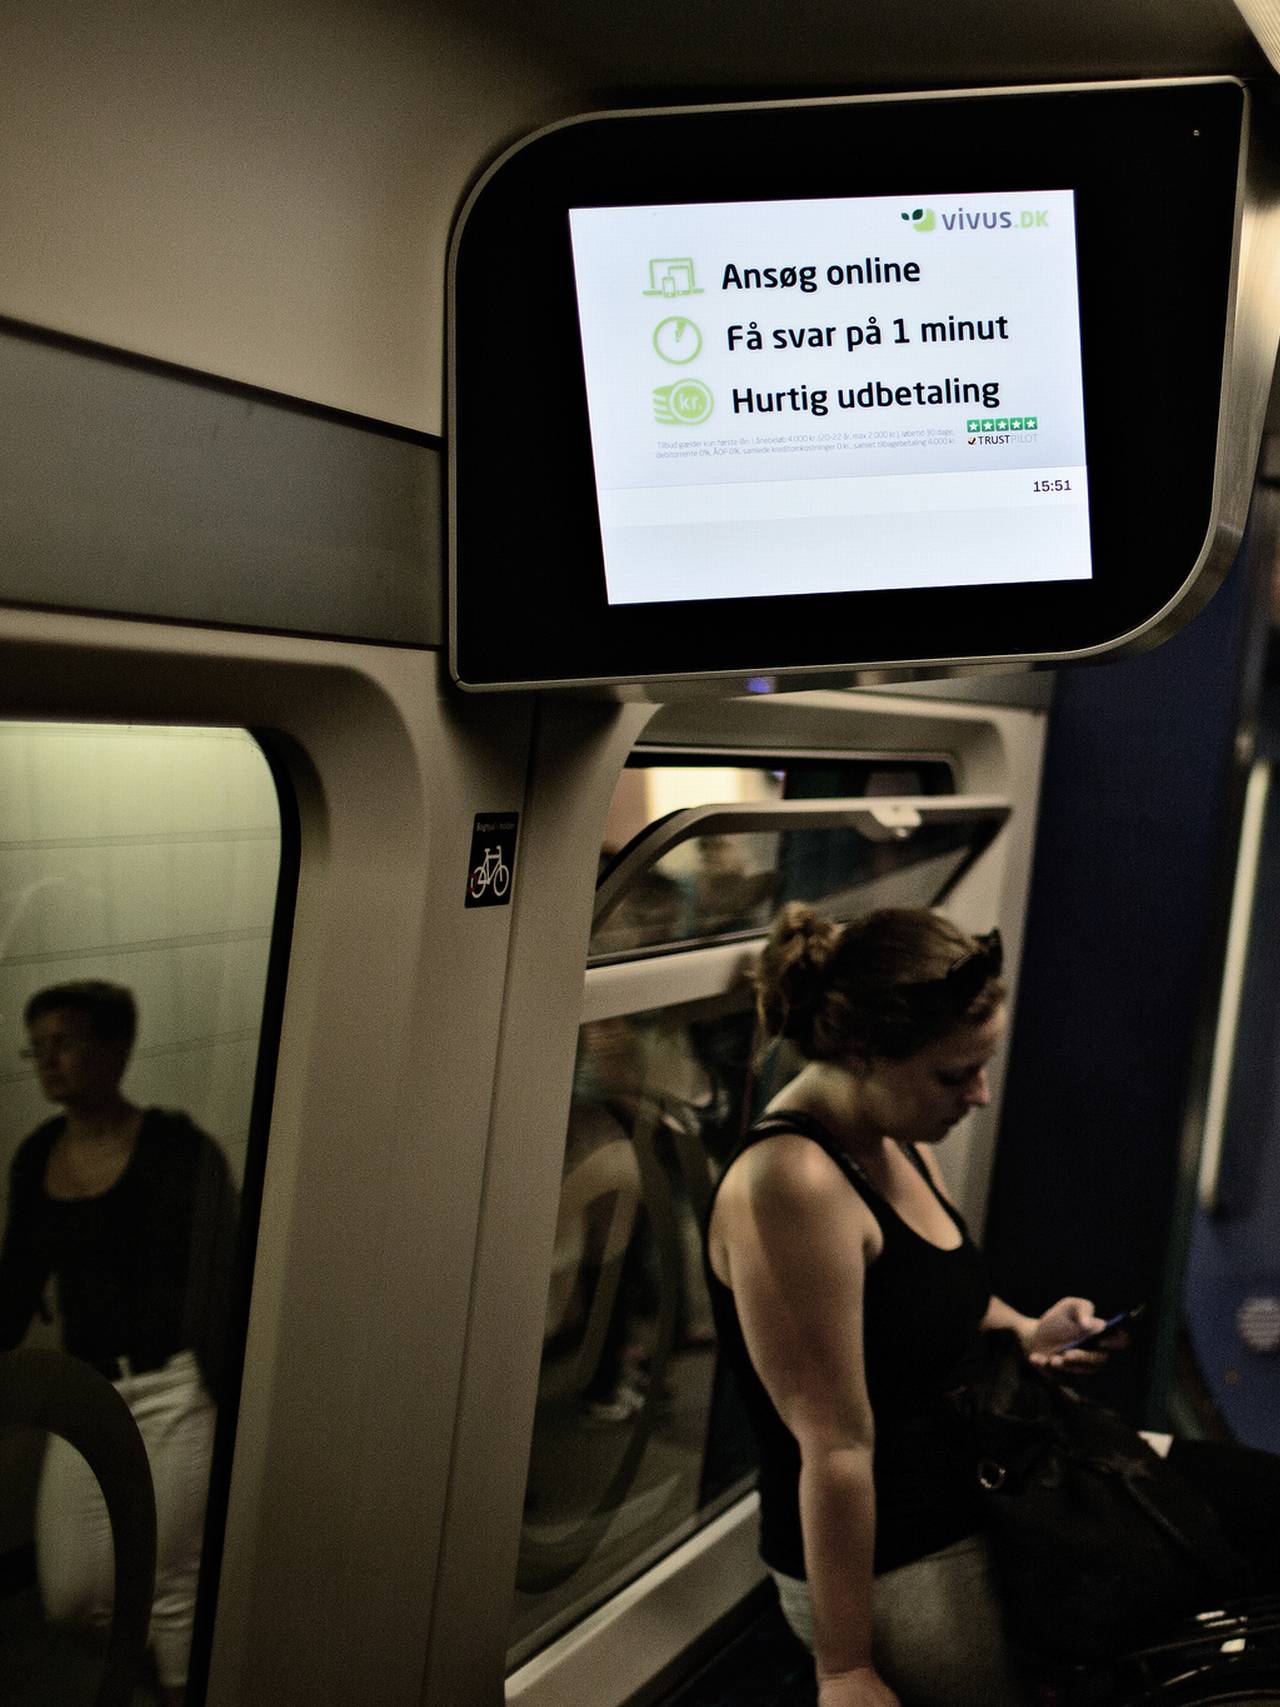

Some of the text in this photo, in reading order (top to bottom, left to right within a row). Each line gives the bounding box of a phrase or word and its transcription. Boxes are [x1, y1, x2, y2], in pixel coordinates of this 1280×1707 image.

[722, 256, 921, 293] Ansøg online
[727, 315, 1009, 353] Få svar på 1 minut
[679, 392, 703, 411] kr.
[732, 377, 1000, 417] Hurtig udbetaling
[1033, 479, 1072, 494] 15:51
